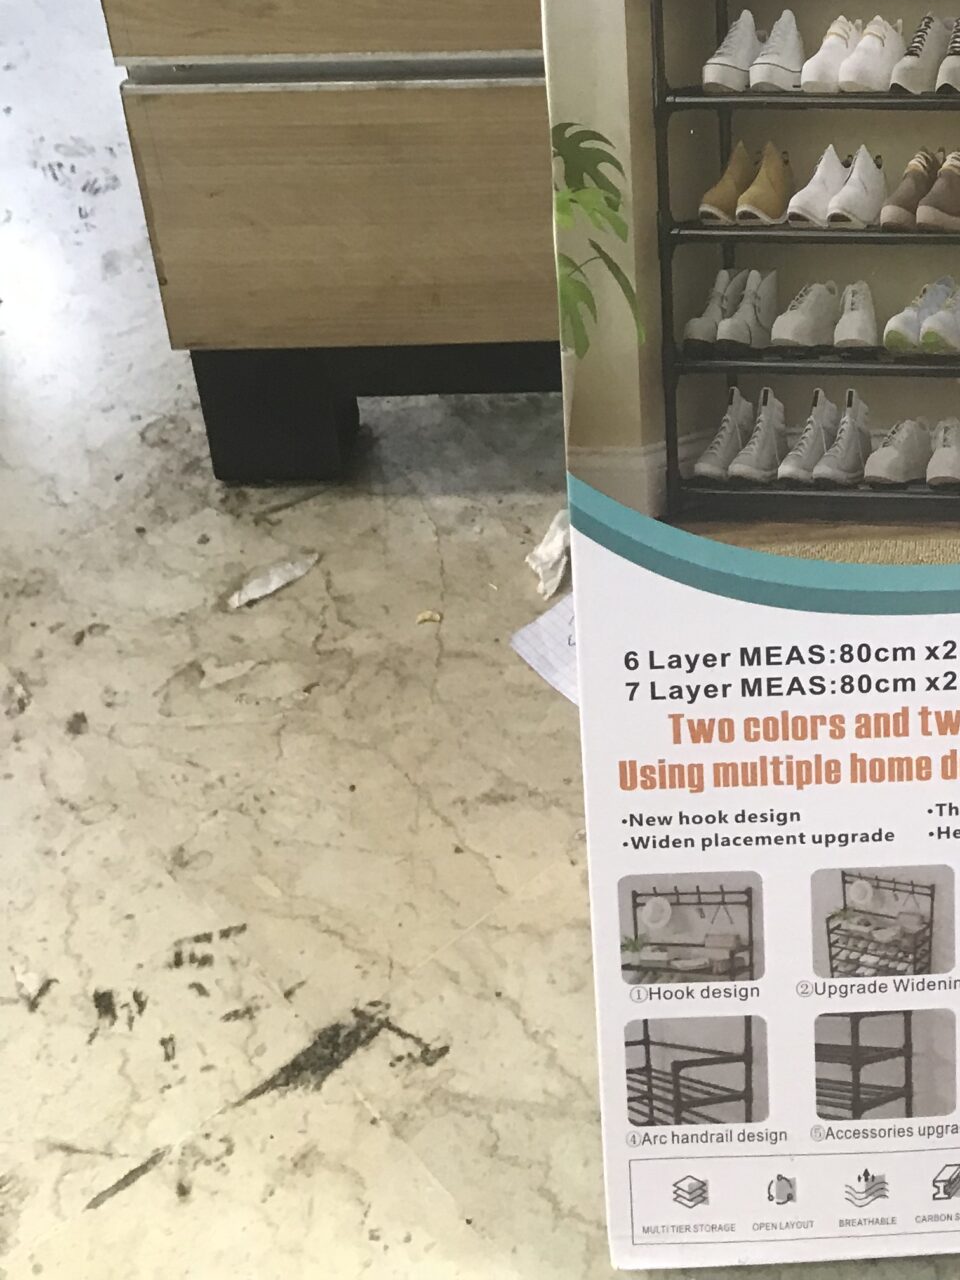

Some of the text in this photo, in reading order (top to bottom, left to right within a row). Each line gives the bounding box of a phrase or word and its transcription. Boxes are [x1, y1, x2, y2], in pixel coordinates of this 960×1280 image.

[624, 651, 639, 670] 6
[648, 648, 732, 674] Layer
[739, 642, 916, 668] MEAS:80cm
[625, 682, 640, 701] 7
[650, 680, 733, 704] Layer
[740, 674, 916, 698] MEAS:80cm
[668, 712, 735, 744] Two
[743, 710, 846, 741] colors
[854, 707, 909, 738] and
[618, 759, 704, 793] Using
[712, 754, 841, 790] multiple
[850, 751, 932, 783] home
[629, 807, 801, 827] New hook design
[631, 827, 896, 850] Widen placement upgrade
[700, 983, 761, 1002] design
[671, 1128, 733, 1145] handrail
[738, 1127, 788, 1145] design
[692, 1223, 736, 1234] STORAGE
[752, 1220, 815, 1231] OPEN LAYOUT
[839, 1216, 897, 1228] BREATHABLE
[915, 1214, 953, 1224] CARBON
